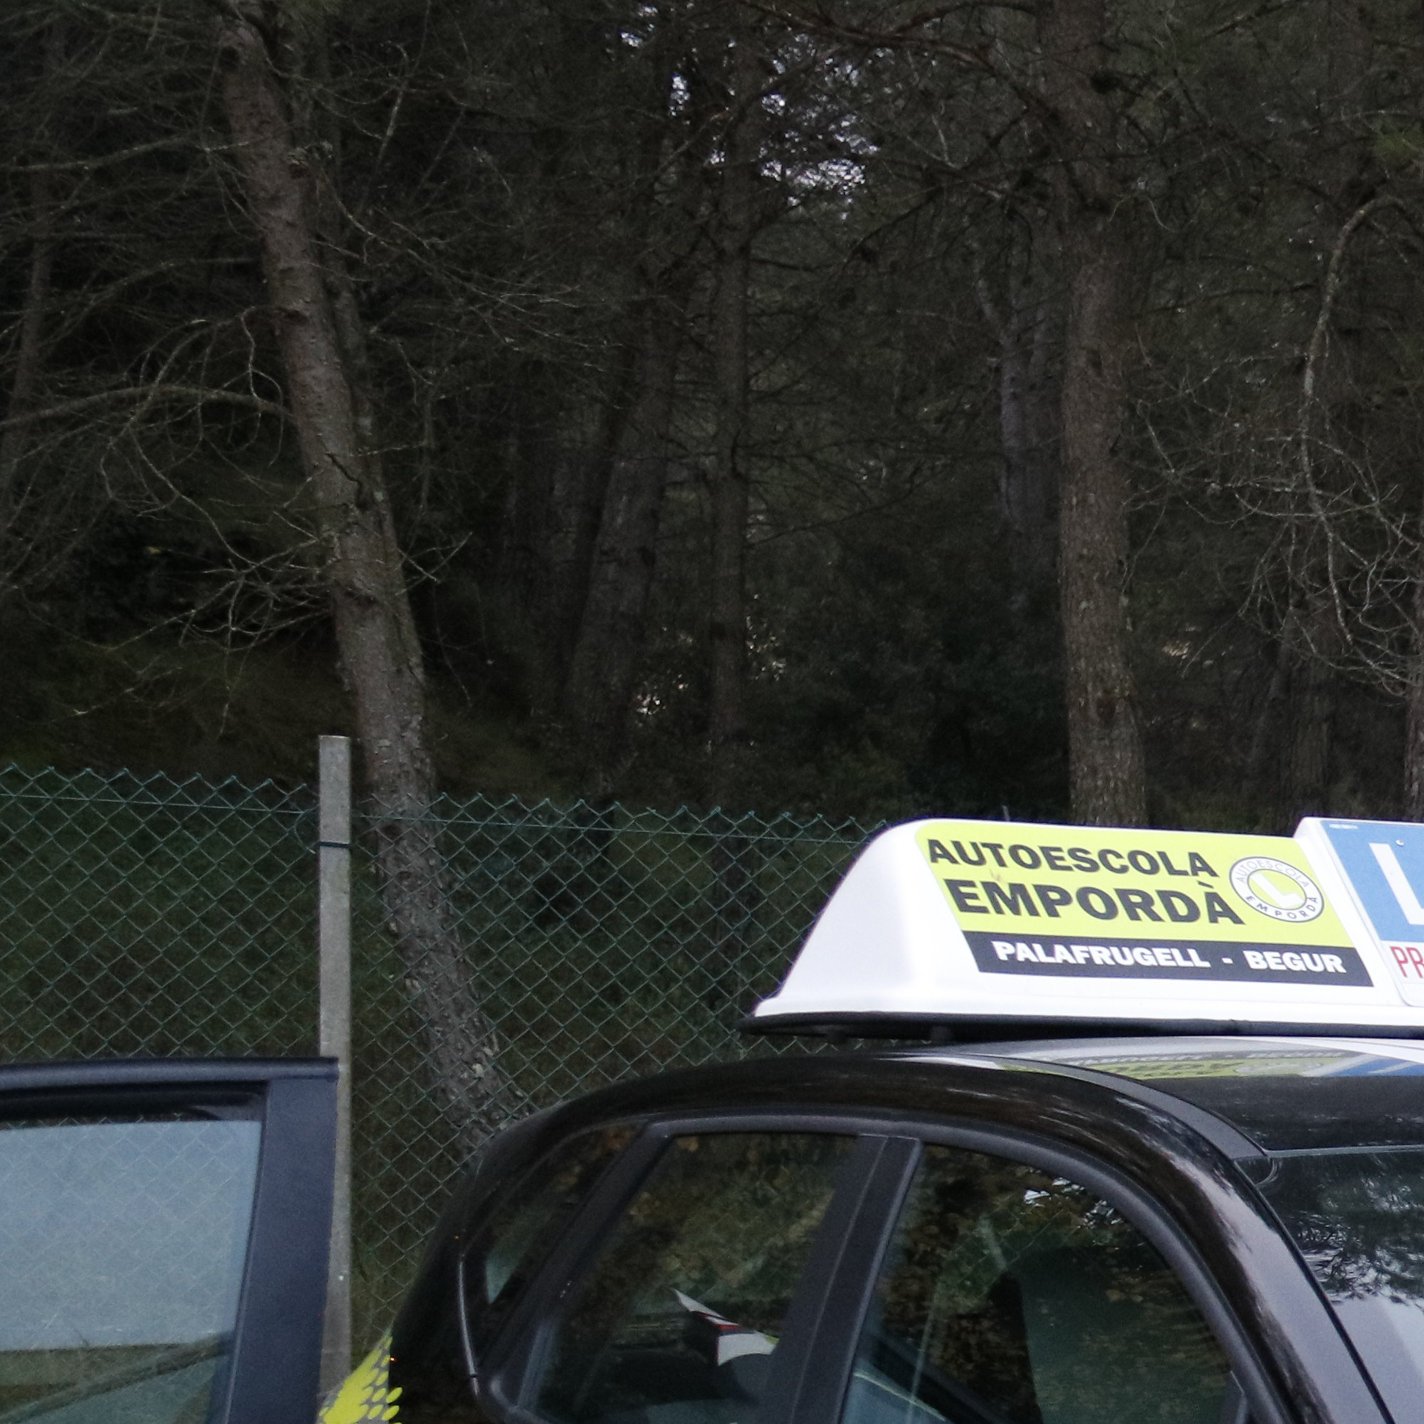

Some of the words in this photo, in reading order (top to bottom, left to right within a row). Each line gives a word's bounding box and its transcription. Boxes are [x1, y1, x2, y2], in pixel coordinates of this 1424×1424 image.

[926, 838, 1220, 878] AUTOESCOLA
[942, 877, 1247, 926] EMPORDÀ
[990, 940, 1212, 968] PALAFRUGELL
[1242, 949, 1348, 974] BEGUR
